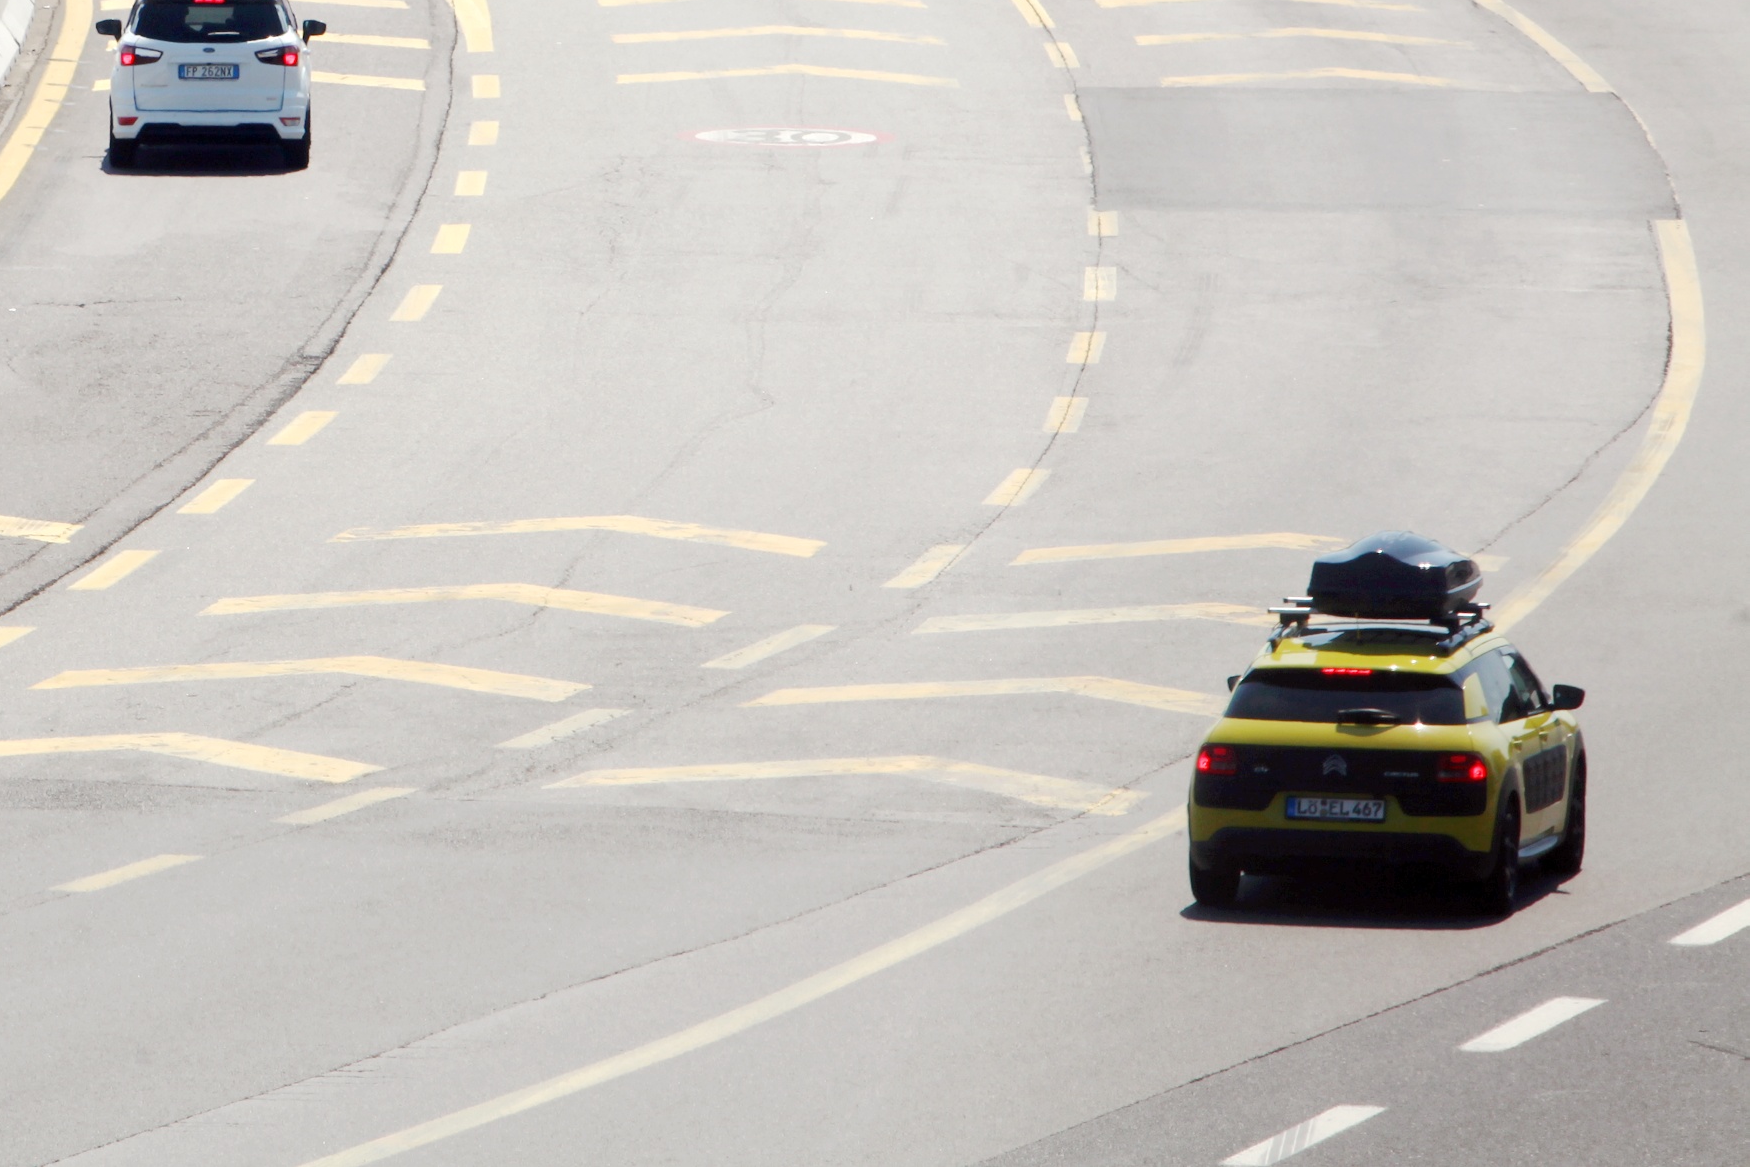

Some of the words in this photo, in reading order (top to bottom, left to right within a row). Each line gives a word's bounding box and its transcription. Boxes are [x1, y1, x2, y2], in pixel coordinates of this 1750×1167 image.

[185, 66, 198, 77] FP
[201, 66, 233, 78] 262NX
[1329, 801, 1350, 816] EL
[1352, 801, 1383, 817] 467
